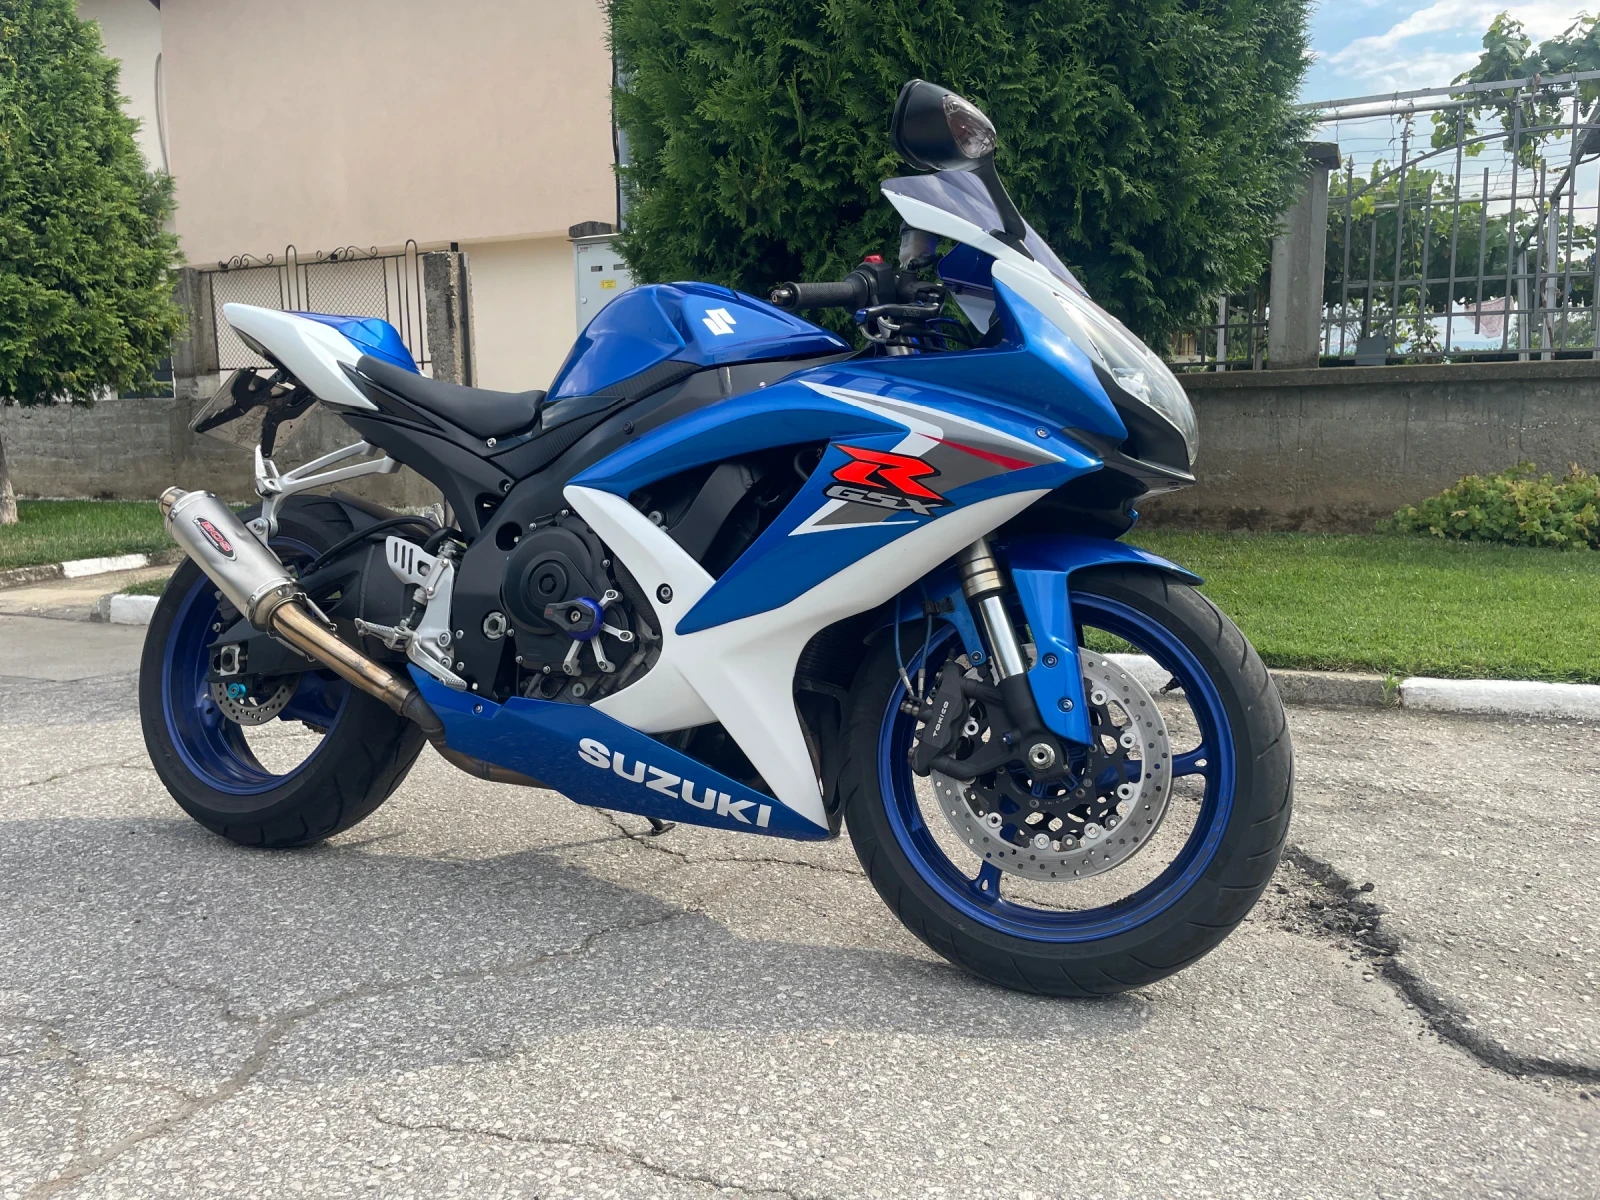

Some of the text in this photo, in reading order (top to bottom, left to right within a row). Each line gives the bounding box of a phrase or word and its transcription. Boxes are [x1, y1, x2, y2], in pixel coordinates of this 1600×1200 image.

[833, 444, 944, 501] R
[825, 485, 943, 516] GSX
[200, 520, 233, 552] BOS
[932, 700, 950, 737] TOKICO
[577, 737, 772, 828] SUZUKI
